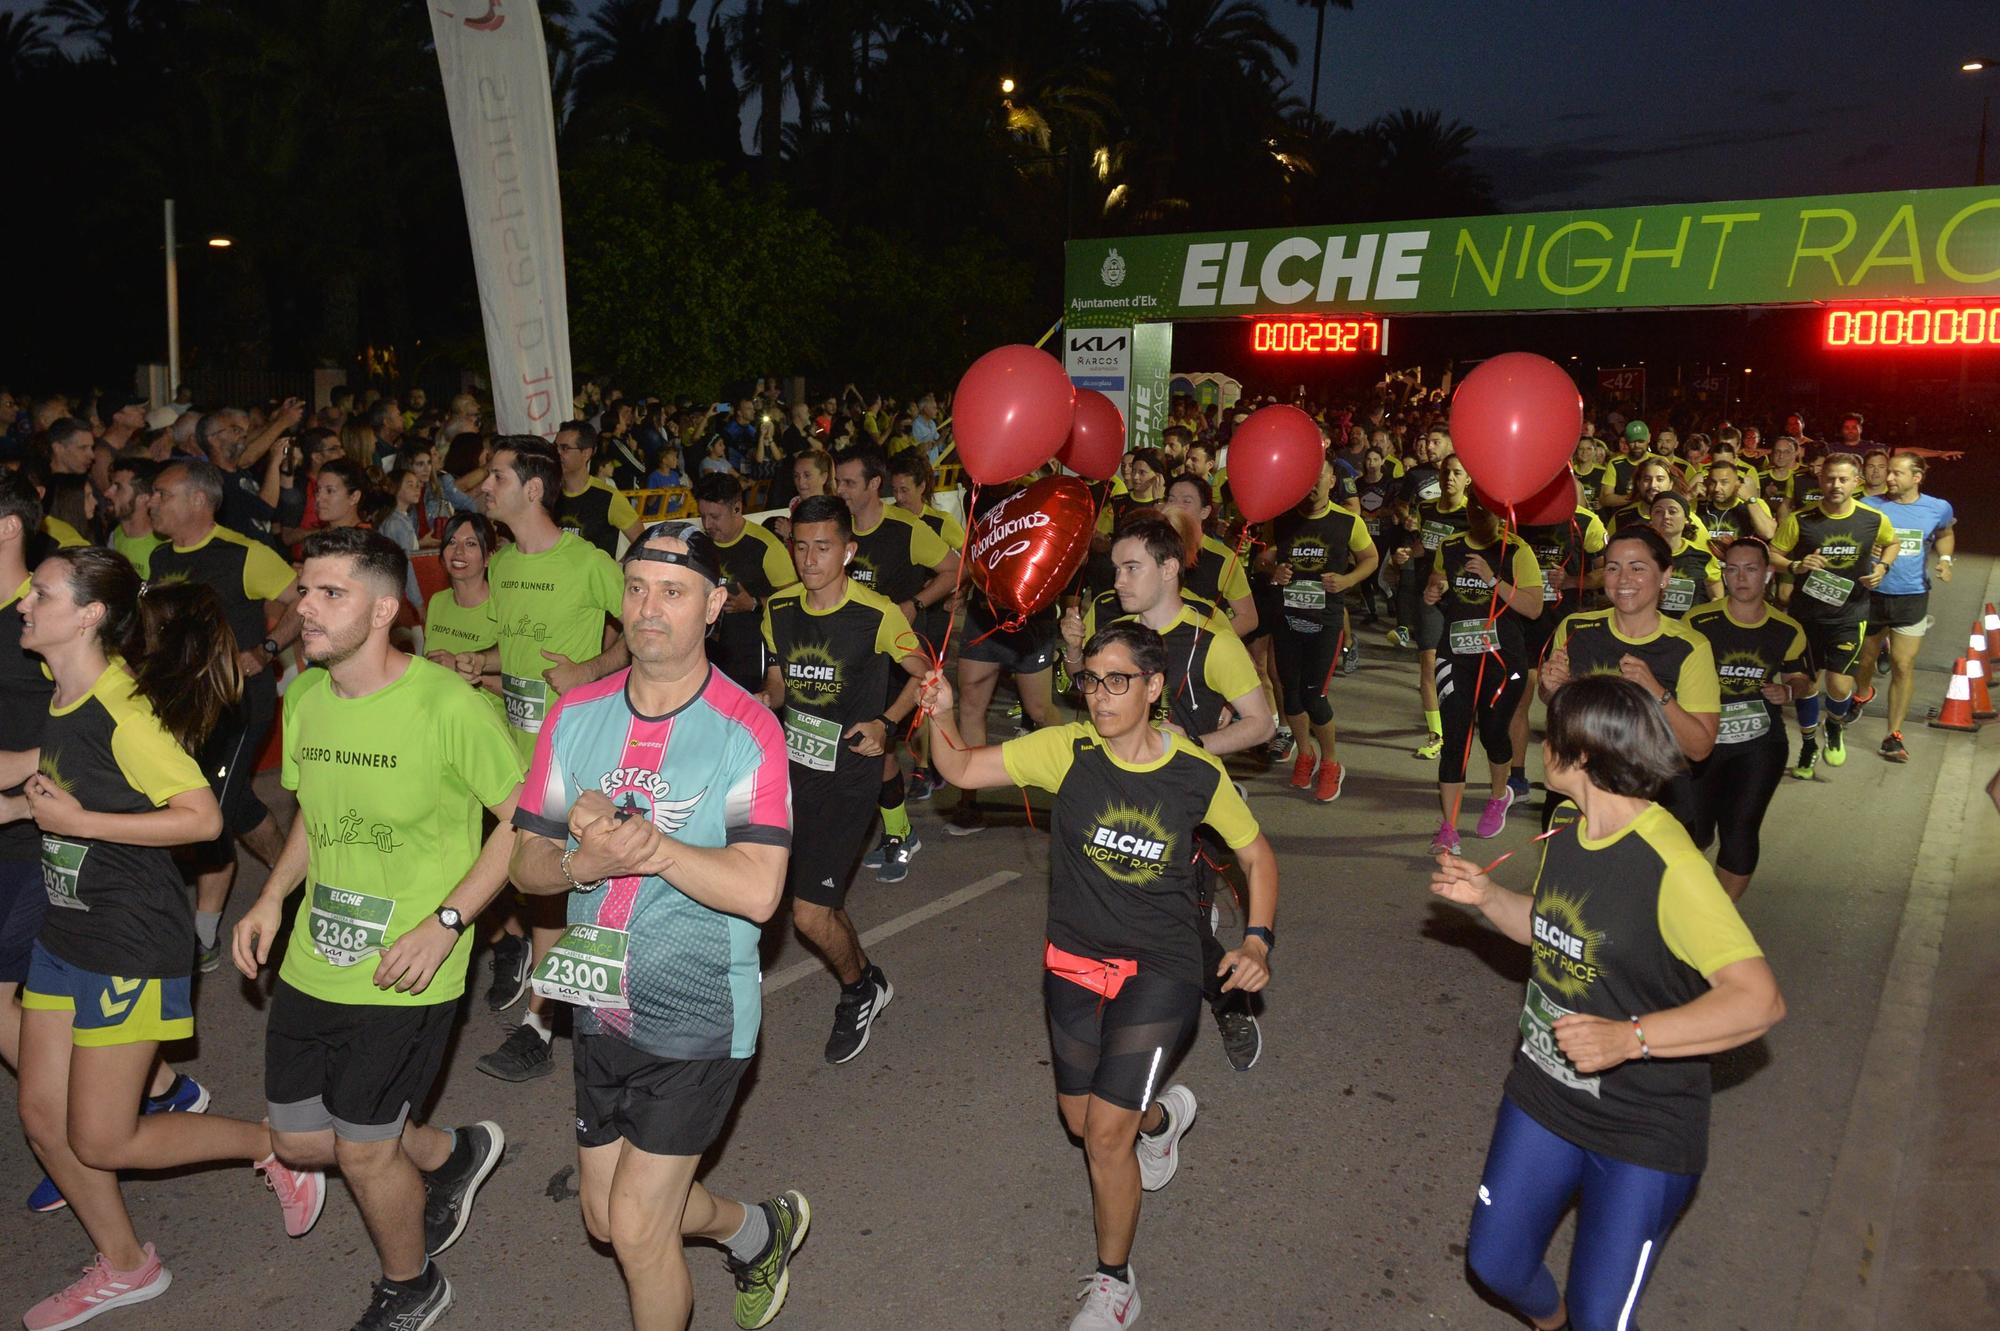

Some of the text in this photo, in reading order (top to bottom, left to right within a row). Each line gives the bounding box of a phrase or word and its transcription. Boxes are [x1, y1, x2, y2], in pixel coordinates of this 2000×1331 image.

[1179, 231, 1430, 307] ELCHE
[1451, 213, 1760, 298] NIGHT
[1071, 296, 1157, 311] Ajuntament d'Elx
[1071, 335, 1126, 352] KIA
[1292, 547, 1325, 557] ELCHE
[1822, 546, 1857, 555] ELCHE
[521, 581, 555, 592] RUNNERS
[1455, 576, 1489, 589] ELCHE
[1811, 581, 1842, 599] 2333
[1289, 592, 1320, 603] 2457
[451, 628, 481, 643] RUNNERS
[789, 664, 835, 681] ELCHE
[1719, 665, 1765, 679] ELCHE
[815, 681, 842, 694] RACE
[505, 696, 535, 719] 2462
[797, 714, 821, 727] ELCHE
[1719, 717, 1762, 734] 2378
[785, 730, 828, 757] 2157
[302, 747, 398, 769] CRESPO RUNNERS
[600, 767, 670, 800] ESTESO
[1093, 827, 1165, 860] ELCHE
[1082, 844, 1129, 866] NIGHT
[330, 890, 365, 906] ELCHE
[316, 918, 368, 951] 2368
[570, 926, 599, 941] ELCHE
[1534, 915, 1583, 960] ELCHE
[544, 956, 608, 992] 2300
